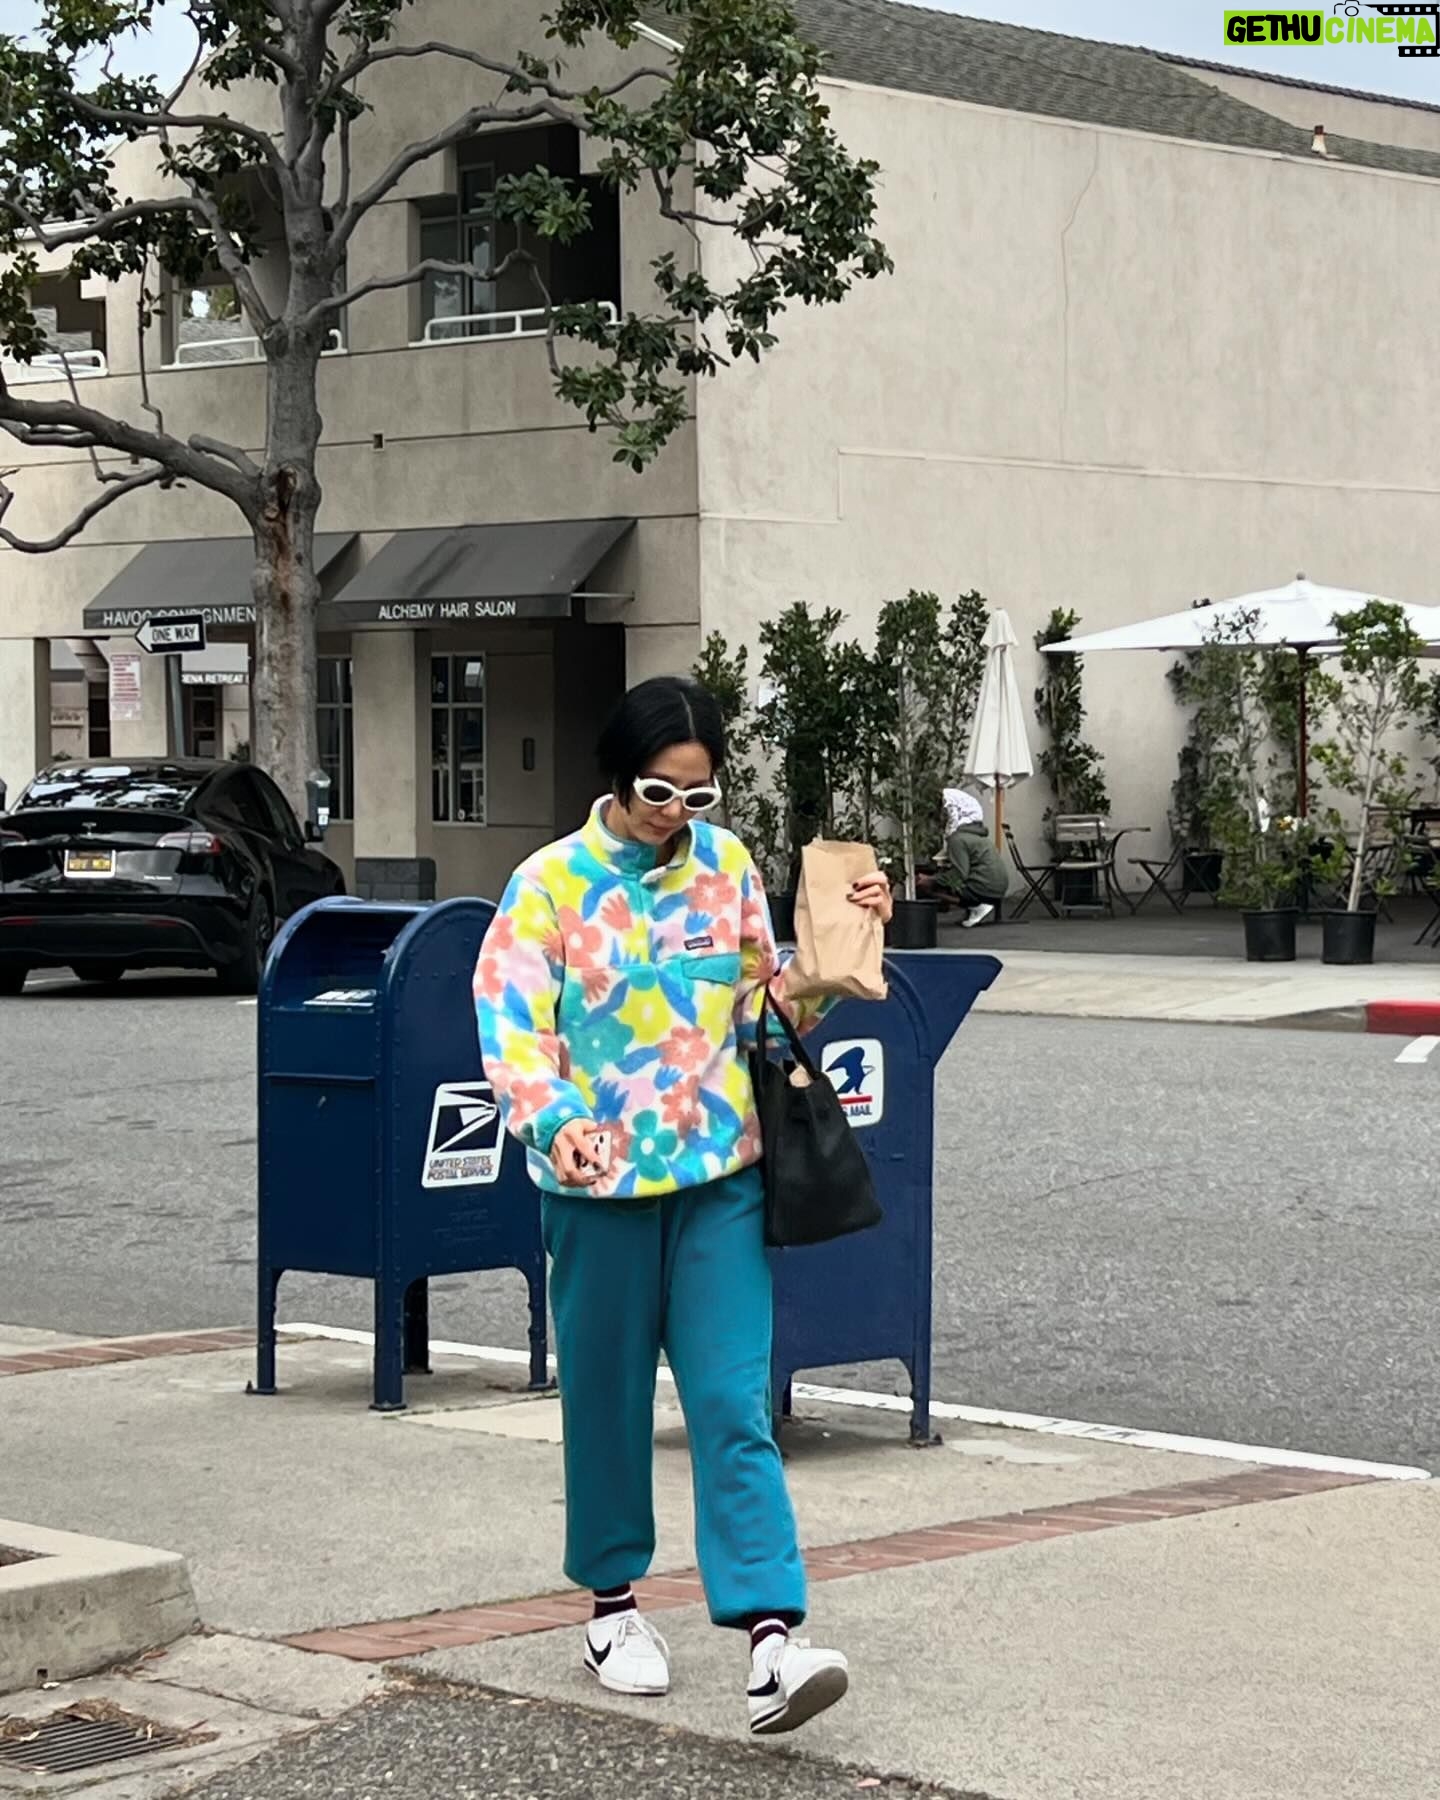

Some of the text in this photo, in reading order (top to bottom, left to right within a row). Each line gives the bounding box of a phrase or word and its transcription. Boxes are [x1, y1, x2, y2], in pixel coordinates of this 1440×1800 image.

[378, 601, 516, 619] ALCHEMY HAIR SALON
[152, 626, 196, 642] ONE WAY
[850, 1104, 872, 1116] MAIL
[429, 1155, 492, 1169] UNITED STATES
[427, 1166, 494, 1180] POSTAL SERVICE
